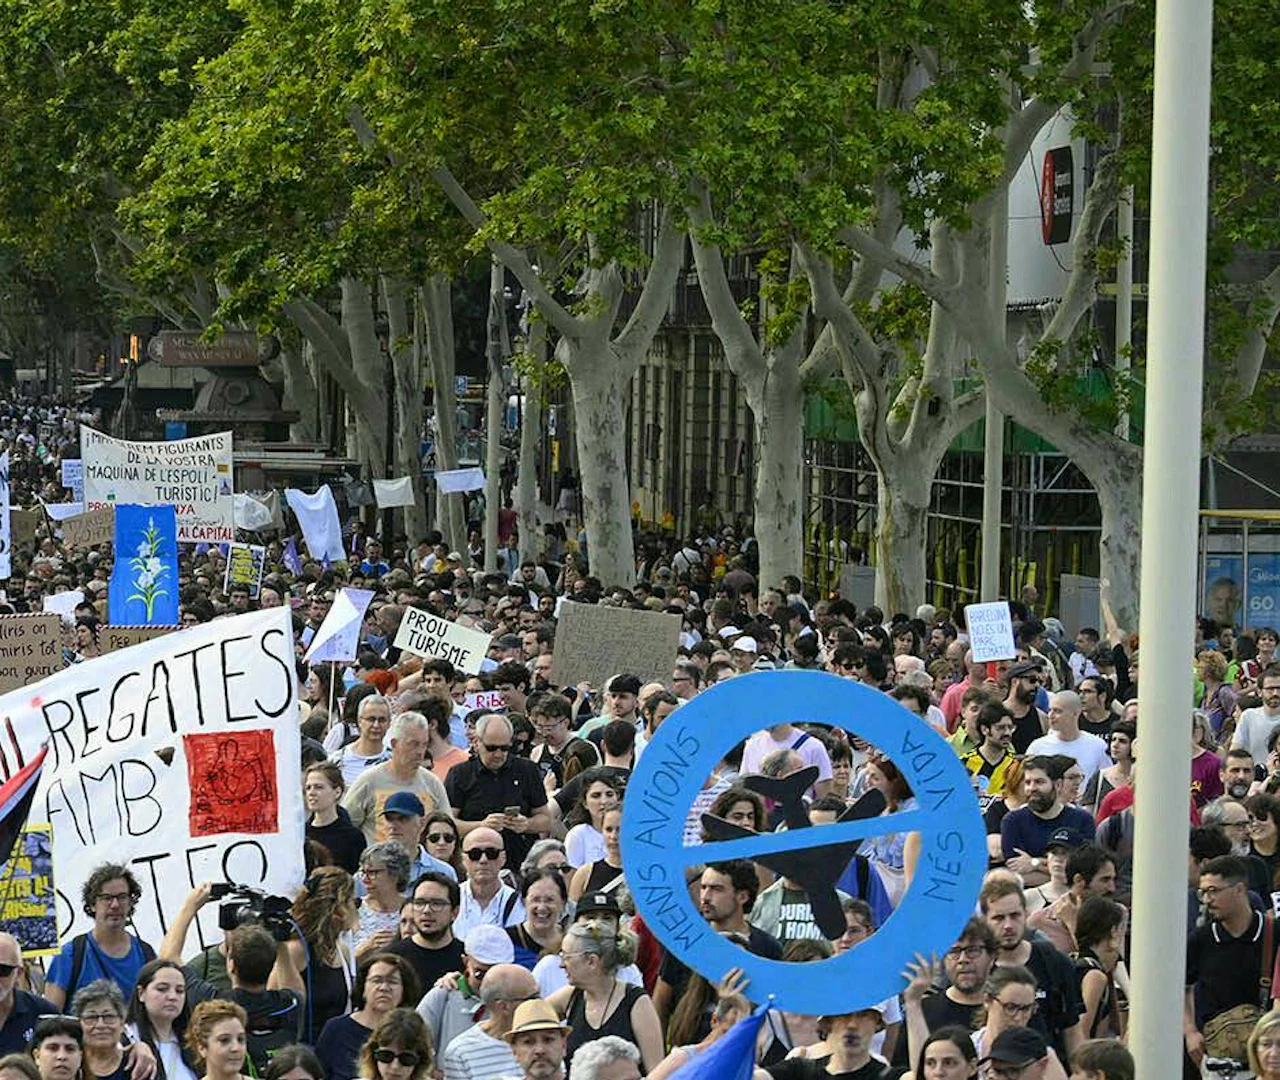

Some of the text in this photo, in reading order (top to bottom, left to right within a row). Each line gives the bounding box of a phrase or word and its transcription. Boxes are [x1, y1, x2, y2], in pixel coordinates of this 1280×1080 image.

[157, 436, 225, 457] FIGURANTS
[165, 453, 216, 468] VOSTRA
[144, 467, 157, 482] DE
[191, 526, 233, 541] CAPITAL
[1250, 595, 1274, 611] 60
[406, 610, 449, 638] PROU
[407, 629, 471, 668] TURISME
[41, 628, 293, 774] REGATES
[634, 726, 701, 849] AVIONS
[899, 729, 956, 814] VIDA
[45, 761, 163, 846] AMB
[923, 830, 965, 903] MÉS
